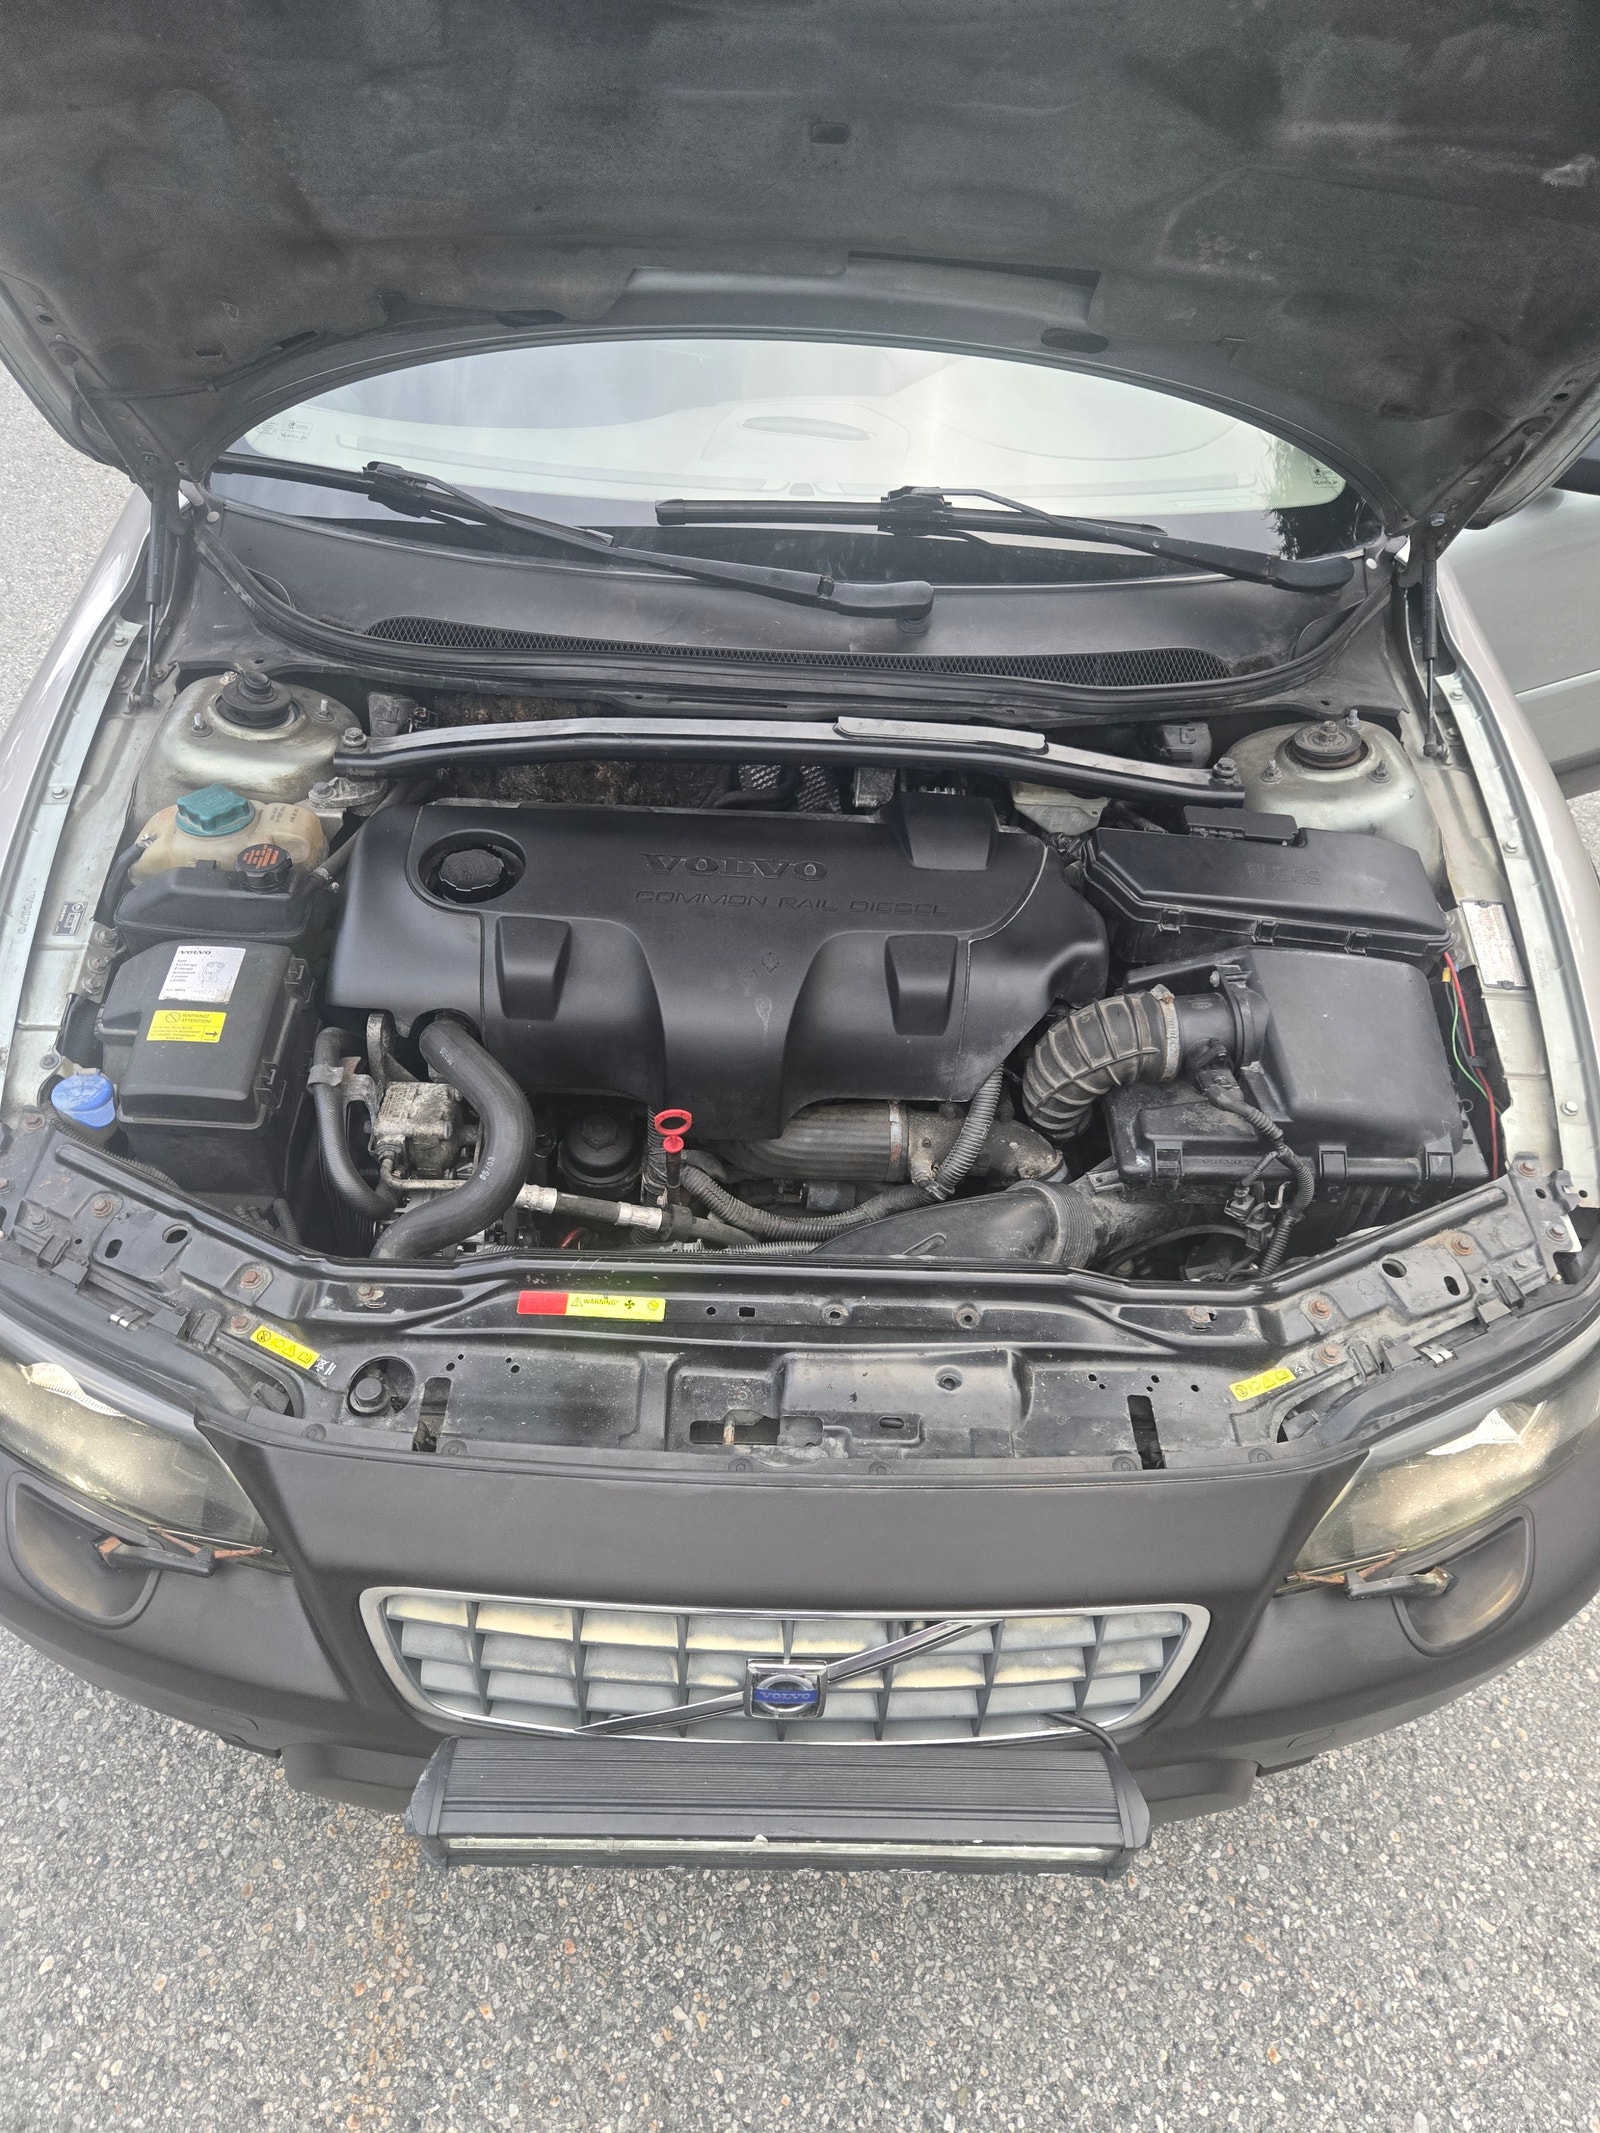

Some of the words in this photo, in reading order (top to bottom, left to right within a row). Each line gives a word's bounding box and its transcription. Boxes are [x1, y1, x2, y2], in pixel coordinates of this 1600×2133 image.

[640, 853, 828, 881] VOLVO
[635, 890, 768, 908] COMMON
[778, 896, 839, 912] RAIL
[849, 899, 950, 917] DIESEL
[583, 1298, 619, 1306] WARNING!
[760, 1691, 811, 1700] VOLVO
